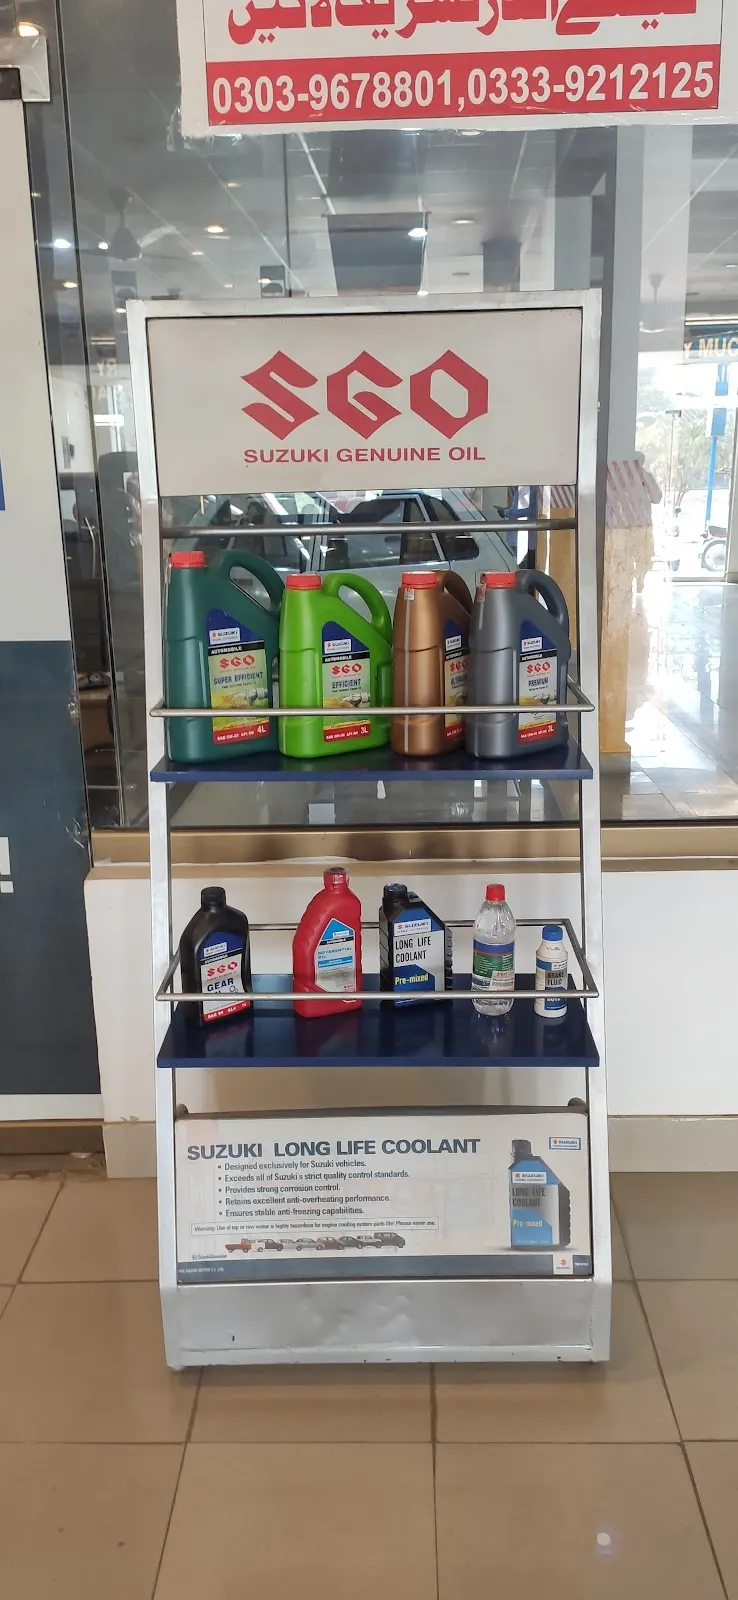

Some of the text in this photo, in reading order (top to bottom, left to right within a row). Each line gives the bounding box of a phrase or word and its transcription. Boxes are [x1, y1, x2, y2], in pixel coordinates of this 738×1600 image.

[212, 61, 714, 113] 0303-9678801,0333-9212125
[240, 349, 489, 440] SGO
[243, 446, 486, 463] SUZUKI GENUINE OIL
[211, 646, 242, 654] AUTOMOBILE
[220, 654, 255, 669] SGO
[527, 661, 550, 673] SGO
[332, 663, 362, 675] SGO
[213, 676, 232, 685] SUPER
[234, 671, 263, 682] EFFICIENT
[332, 679, 361, 689] EFFICIENT
[529, 677, 549, 687] PREMIUM
[257, 725, 266, 733] 4L
[361, 726, 369, 734] 3L
[395, 936, 431, 950] LONG LIFE
[395, 950, 427, 963] COOLANT
[207, 961, 238, 977] SGO
[207, 978, 234, 992] GEAR
[395, 973, 429, 986] Pre-mixed
[187, 1139, 481, 1160] SUZUKI LONG LIFE COOLANT
[224, 1160, 367, 1171] Designed exclusively for Suzuki vehicles.
[224, 1174, 254, 1182] Exceeds
[274, 1172, 304, 1181] Suzuki's
[304, 1172, 322, 1180] strict
[323, 1171, 347, 1180] quality
[374, 1170, 410, 1178] standards.
[225, 1186, 255, 1194] Provides
[256, 1186, 279, 1194] strong
[512, 1188, 546, 1196] LONG LIFE
[225, 1194, 391, 1206] Retains excellent anti-overheating performance.
[512, 1198, 541, 1207] COOLANT
[225, 1207, 364, 1217] Ensures stable anti-freezing capabilities.
[513, 1219, 543, 1227] Pre-mixed
